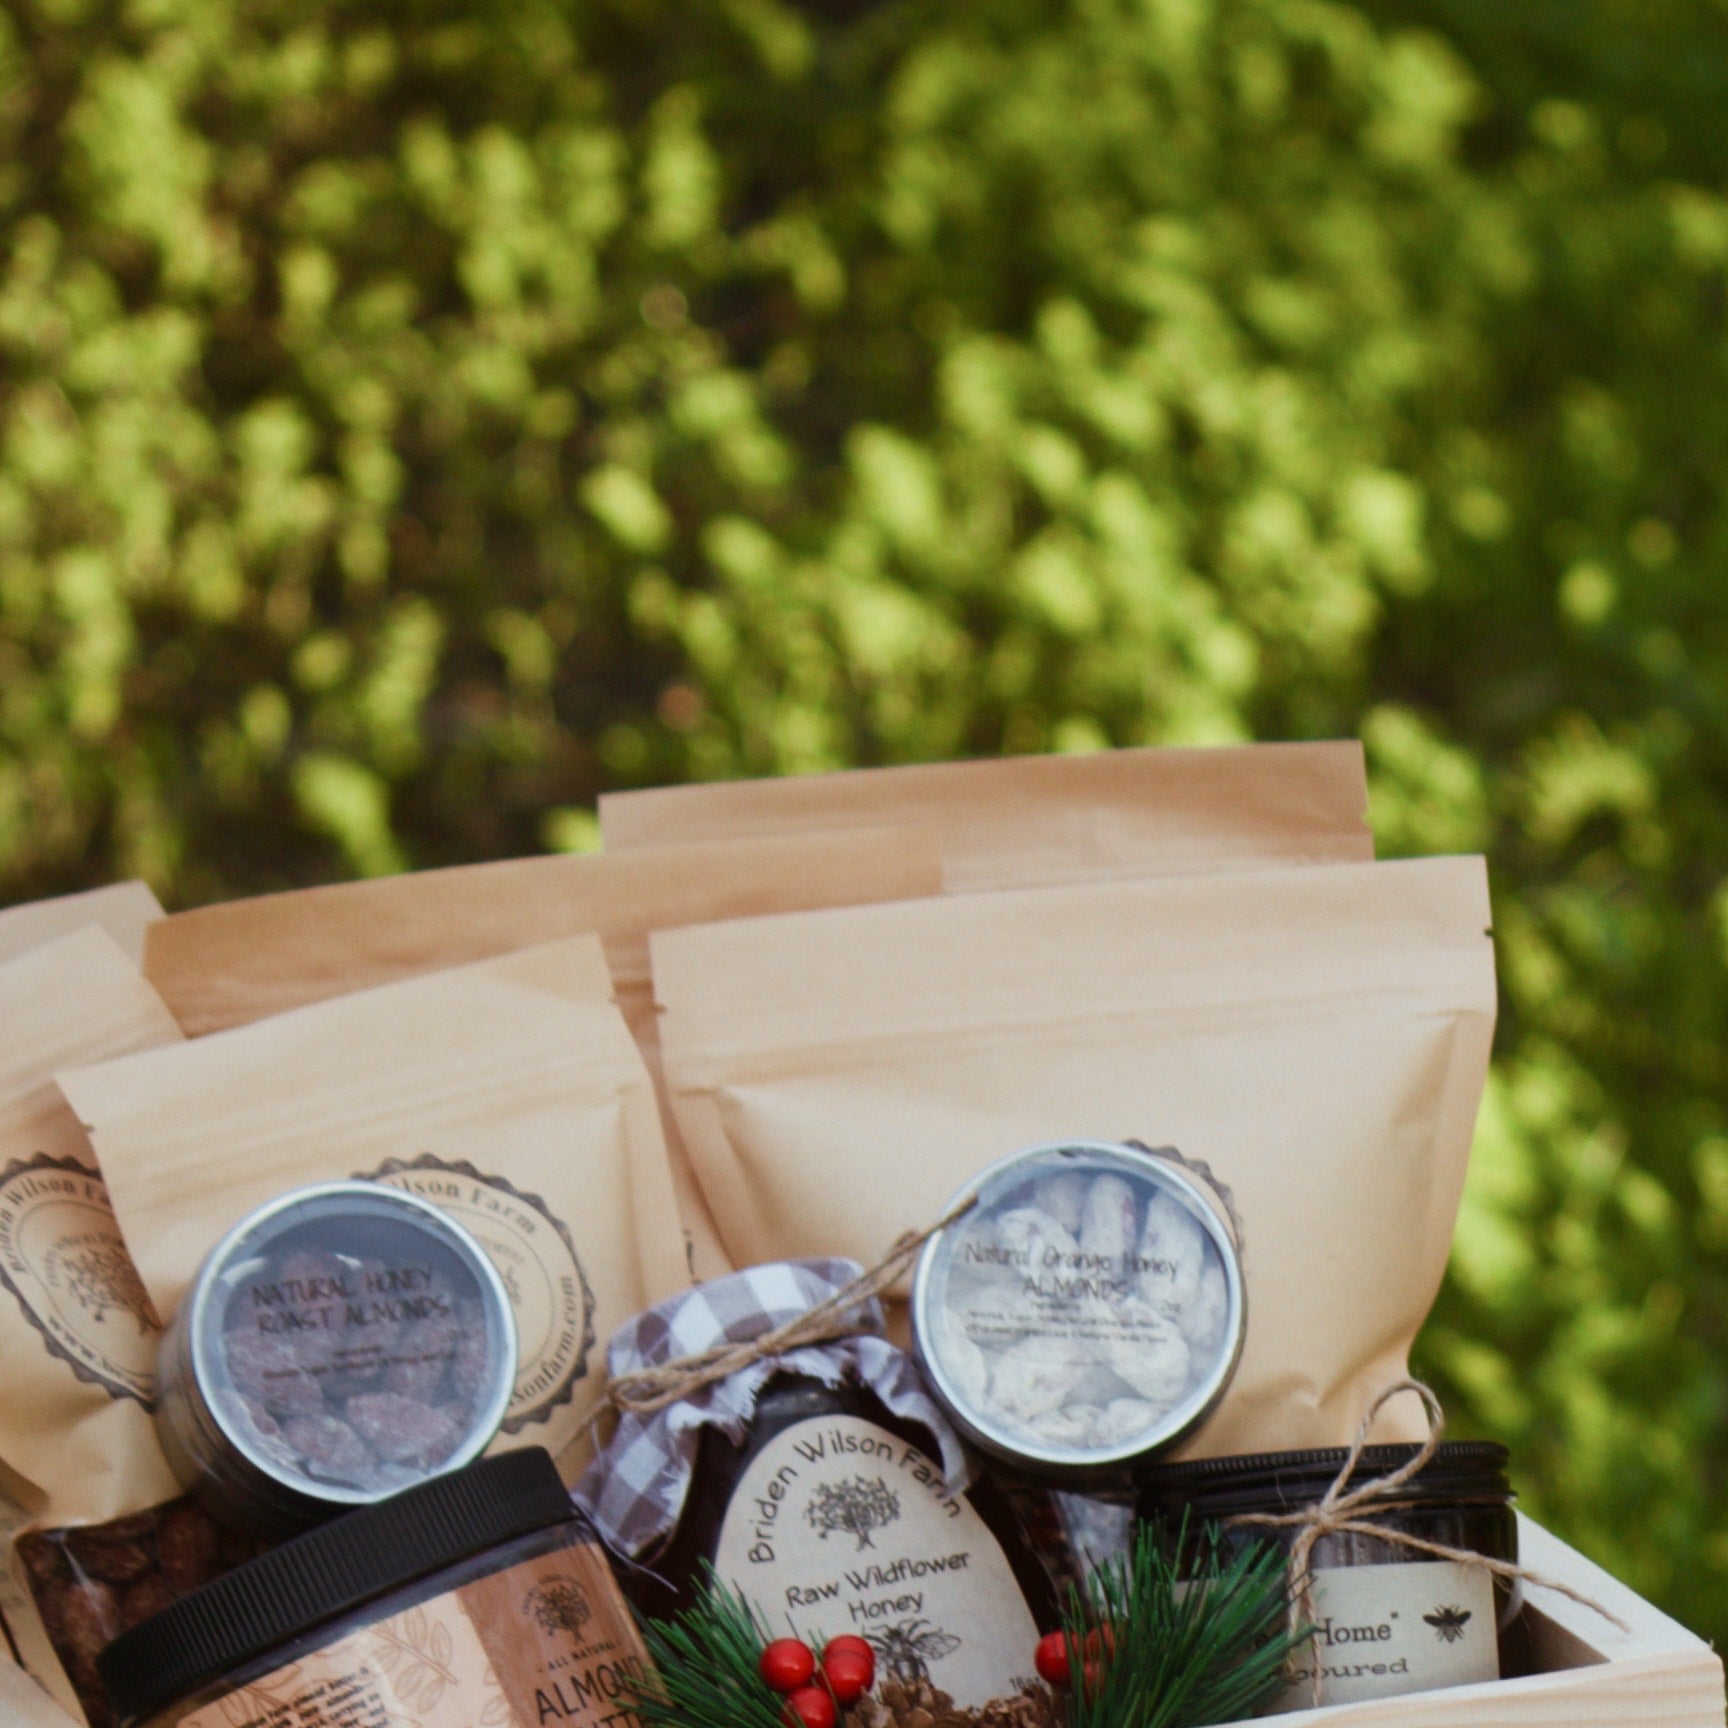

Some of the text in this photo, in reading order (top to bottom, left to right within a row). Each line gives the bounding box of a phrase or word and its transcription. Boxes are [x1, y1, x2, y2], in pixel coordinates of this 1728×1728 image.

[471, 1187, 537, 1235] Farm
[252, 1265, 433, 1306] NATURAL HONEY
[1023, 1274, 1129, 1300] ALMONDS
[257, 1295, 451, 1335] ROAST ALMONDS
[747, 1464, 799, 1565] Briden
[794, 1429, 893, 1463] Wilson
[785, 1550, 971, 1609] Raw Wildflower
[848, 1591, 923, 1623] Honey
[534, 1655, 648, 1726] ALMOND
